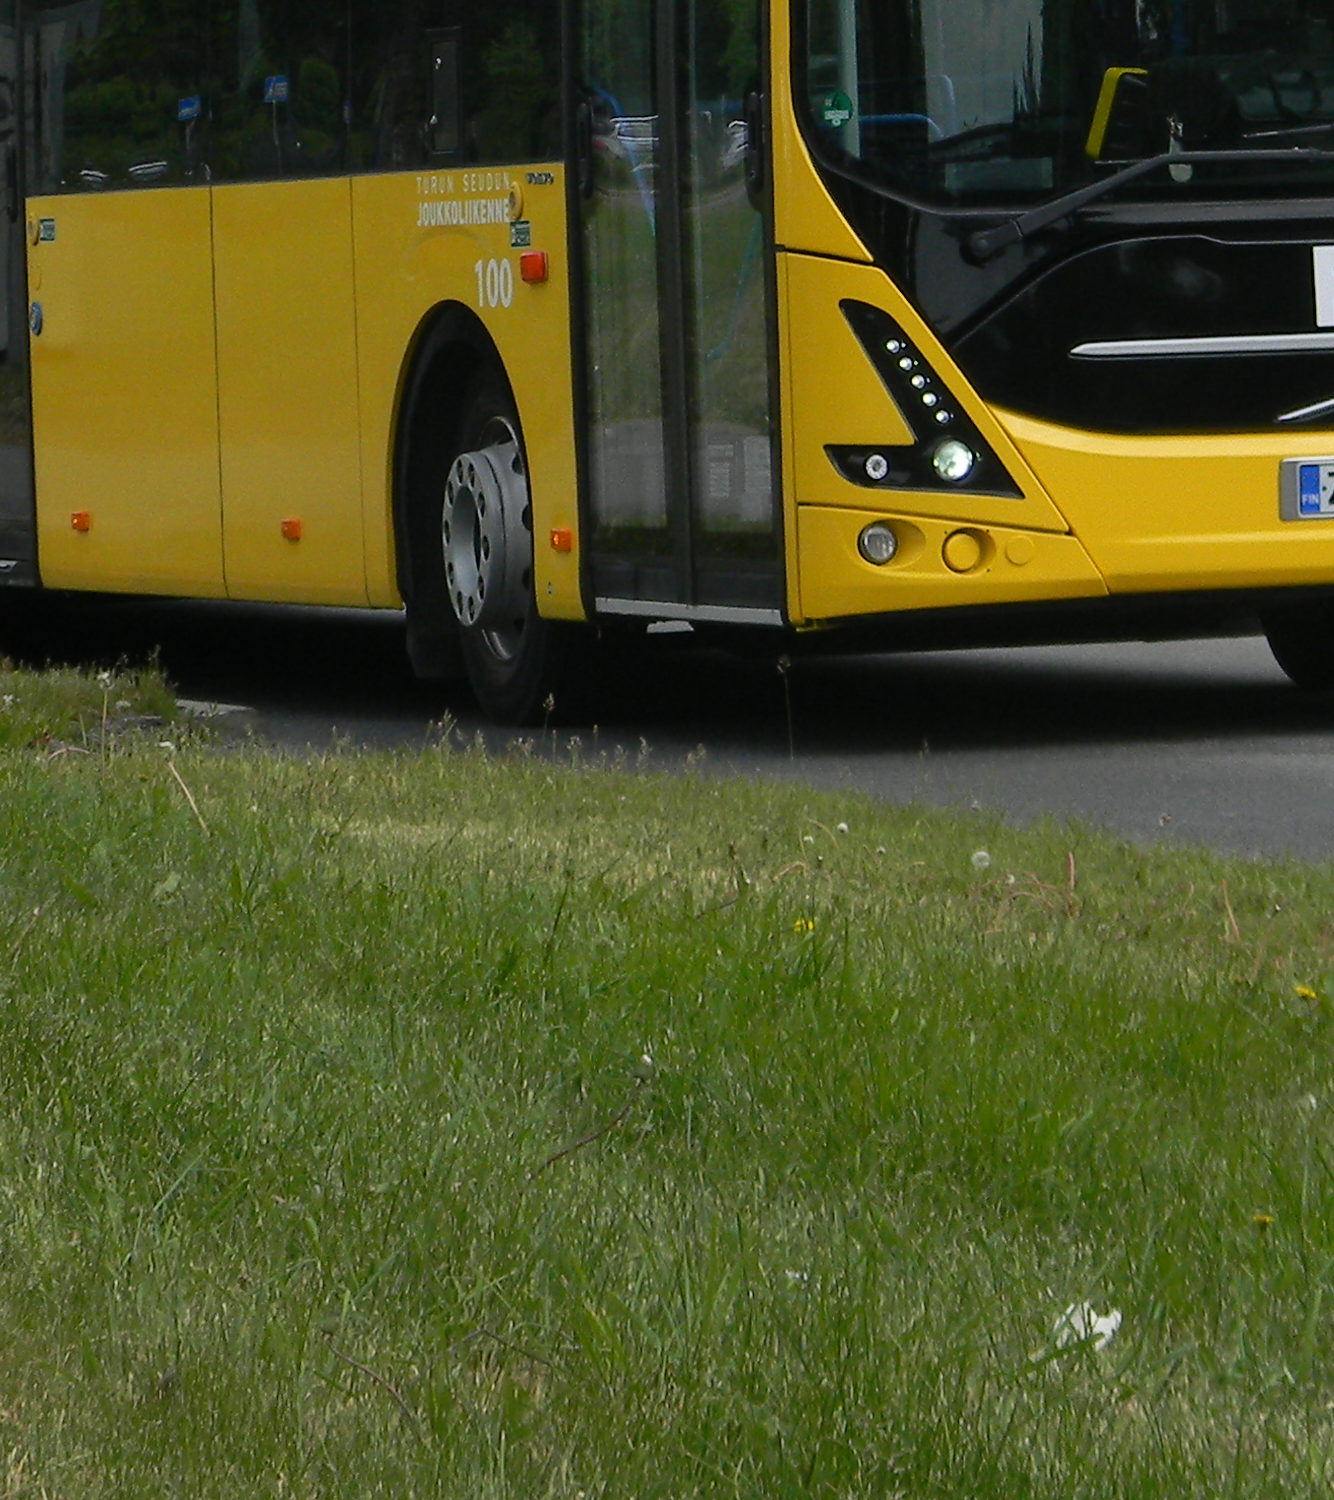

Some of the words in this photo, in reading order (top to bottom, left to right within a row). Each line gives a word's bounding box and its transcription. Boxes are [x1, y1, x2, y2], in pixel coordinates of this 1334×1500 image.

[415, 175, 454, 194] TURUN
[463, 172, 510, 192] SEUDUN
[417, 198, 511, 227] JOUKKOLIIKENNE
[474, 257, 513, 308] 100
[1302, 492, 1319, 506] FIN
